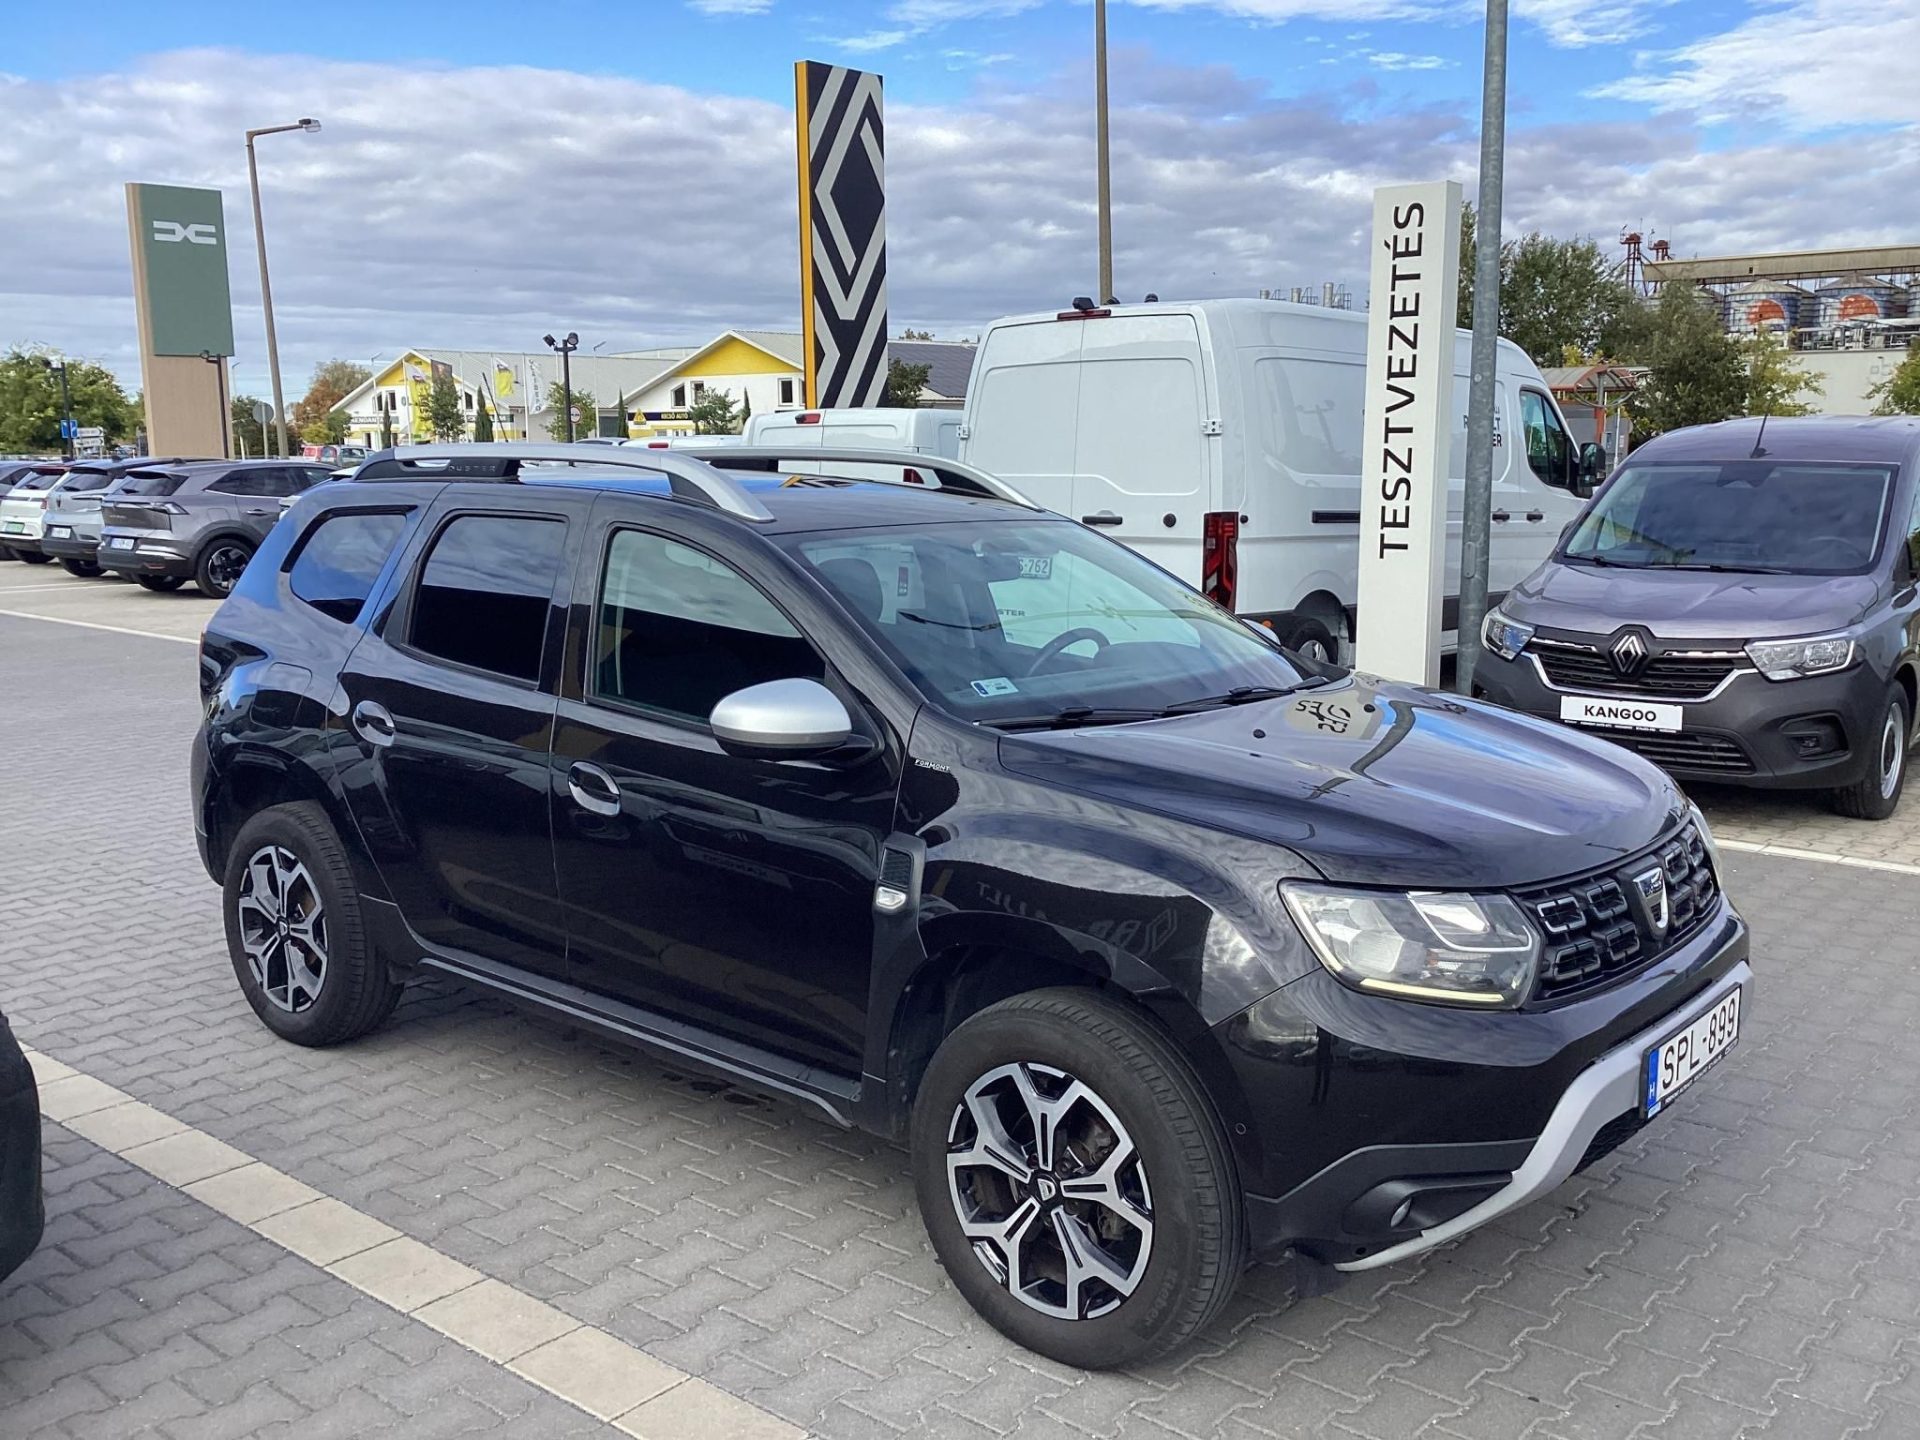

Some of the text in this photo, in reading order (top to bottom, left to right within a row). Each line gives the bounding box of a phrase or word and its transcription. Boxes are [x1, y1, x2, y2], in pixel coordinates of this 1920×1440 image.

[1379, 202, 1424, 560] TESZTVEZETÉS
[1018, 559, 1048, 574] S-762
[997, 608, 1026, 617] STER
[1584, 705, 1657, 722] KANGOO
[1662, 998, 1736, 1090] SPL-899
[1649, 1081, 1656, 1099] H
